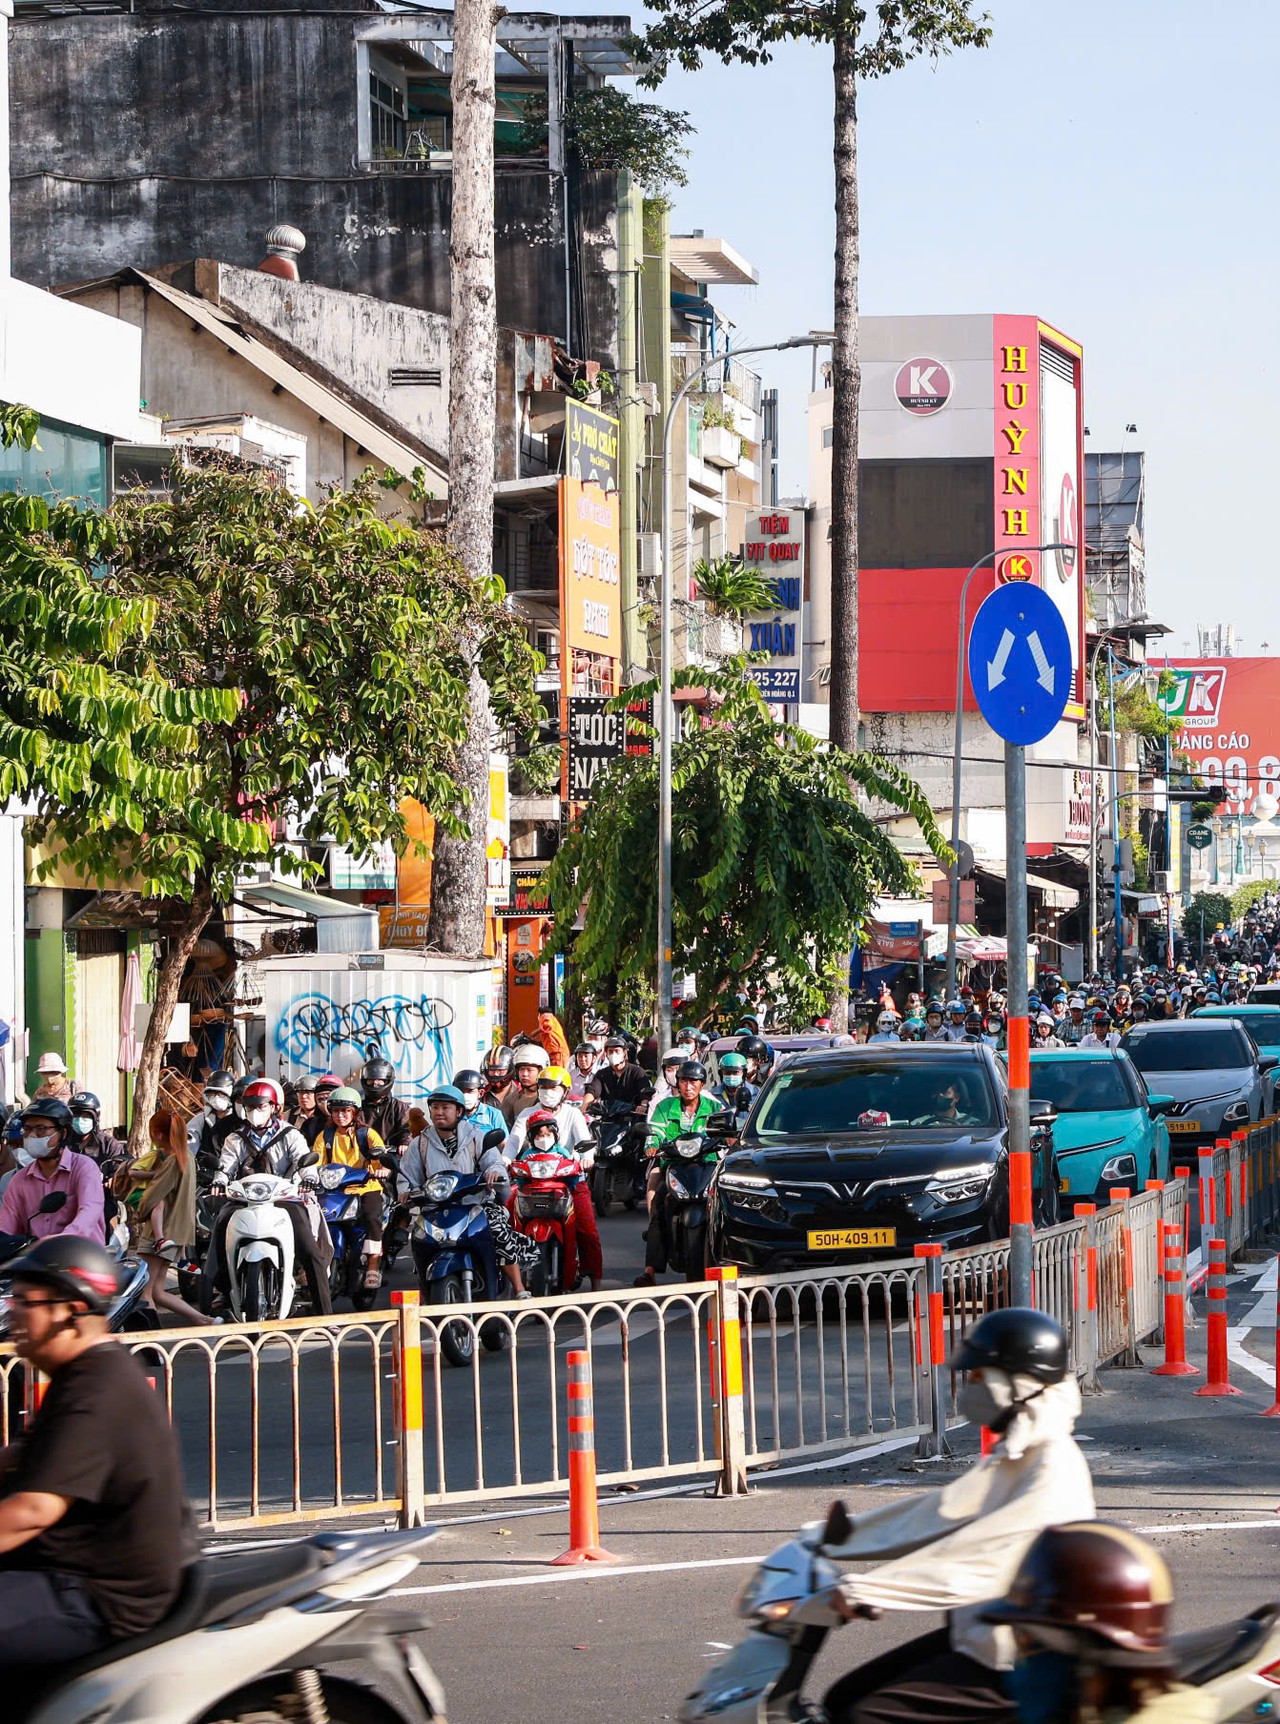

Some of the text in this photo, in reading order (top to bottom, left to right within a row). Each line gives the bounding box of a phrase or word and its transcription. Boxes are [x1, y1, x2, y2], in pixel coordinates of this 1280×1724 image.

[910, 366, 938, 395] K
[1003, 345, 1029, 536] HUỲNH
[759, 512, 790, 539] TIỆM
[746, 542, 801, 565] VỊT QUAY
[1011, 558, 1027, 575] K
[749, 617, 796, 656] XUÂN
[574, 708, 618, 746] TÓC
[1185, 718, 1216, 726] GROUP
[1217, 731, 1250, 750] CÁO
[815, 1231, 889, 1247] 50H-409.11
